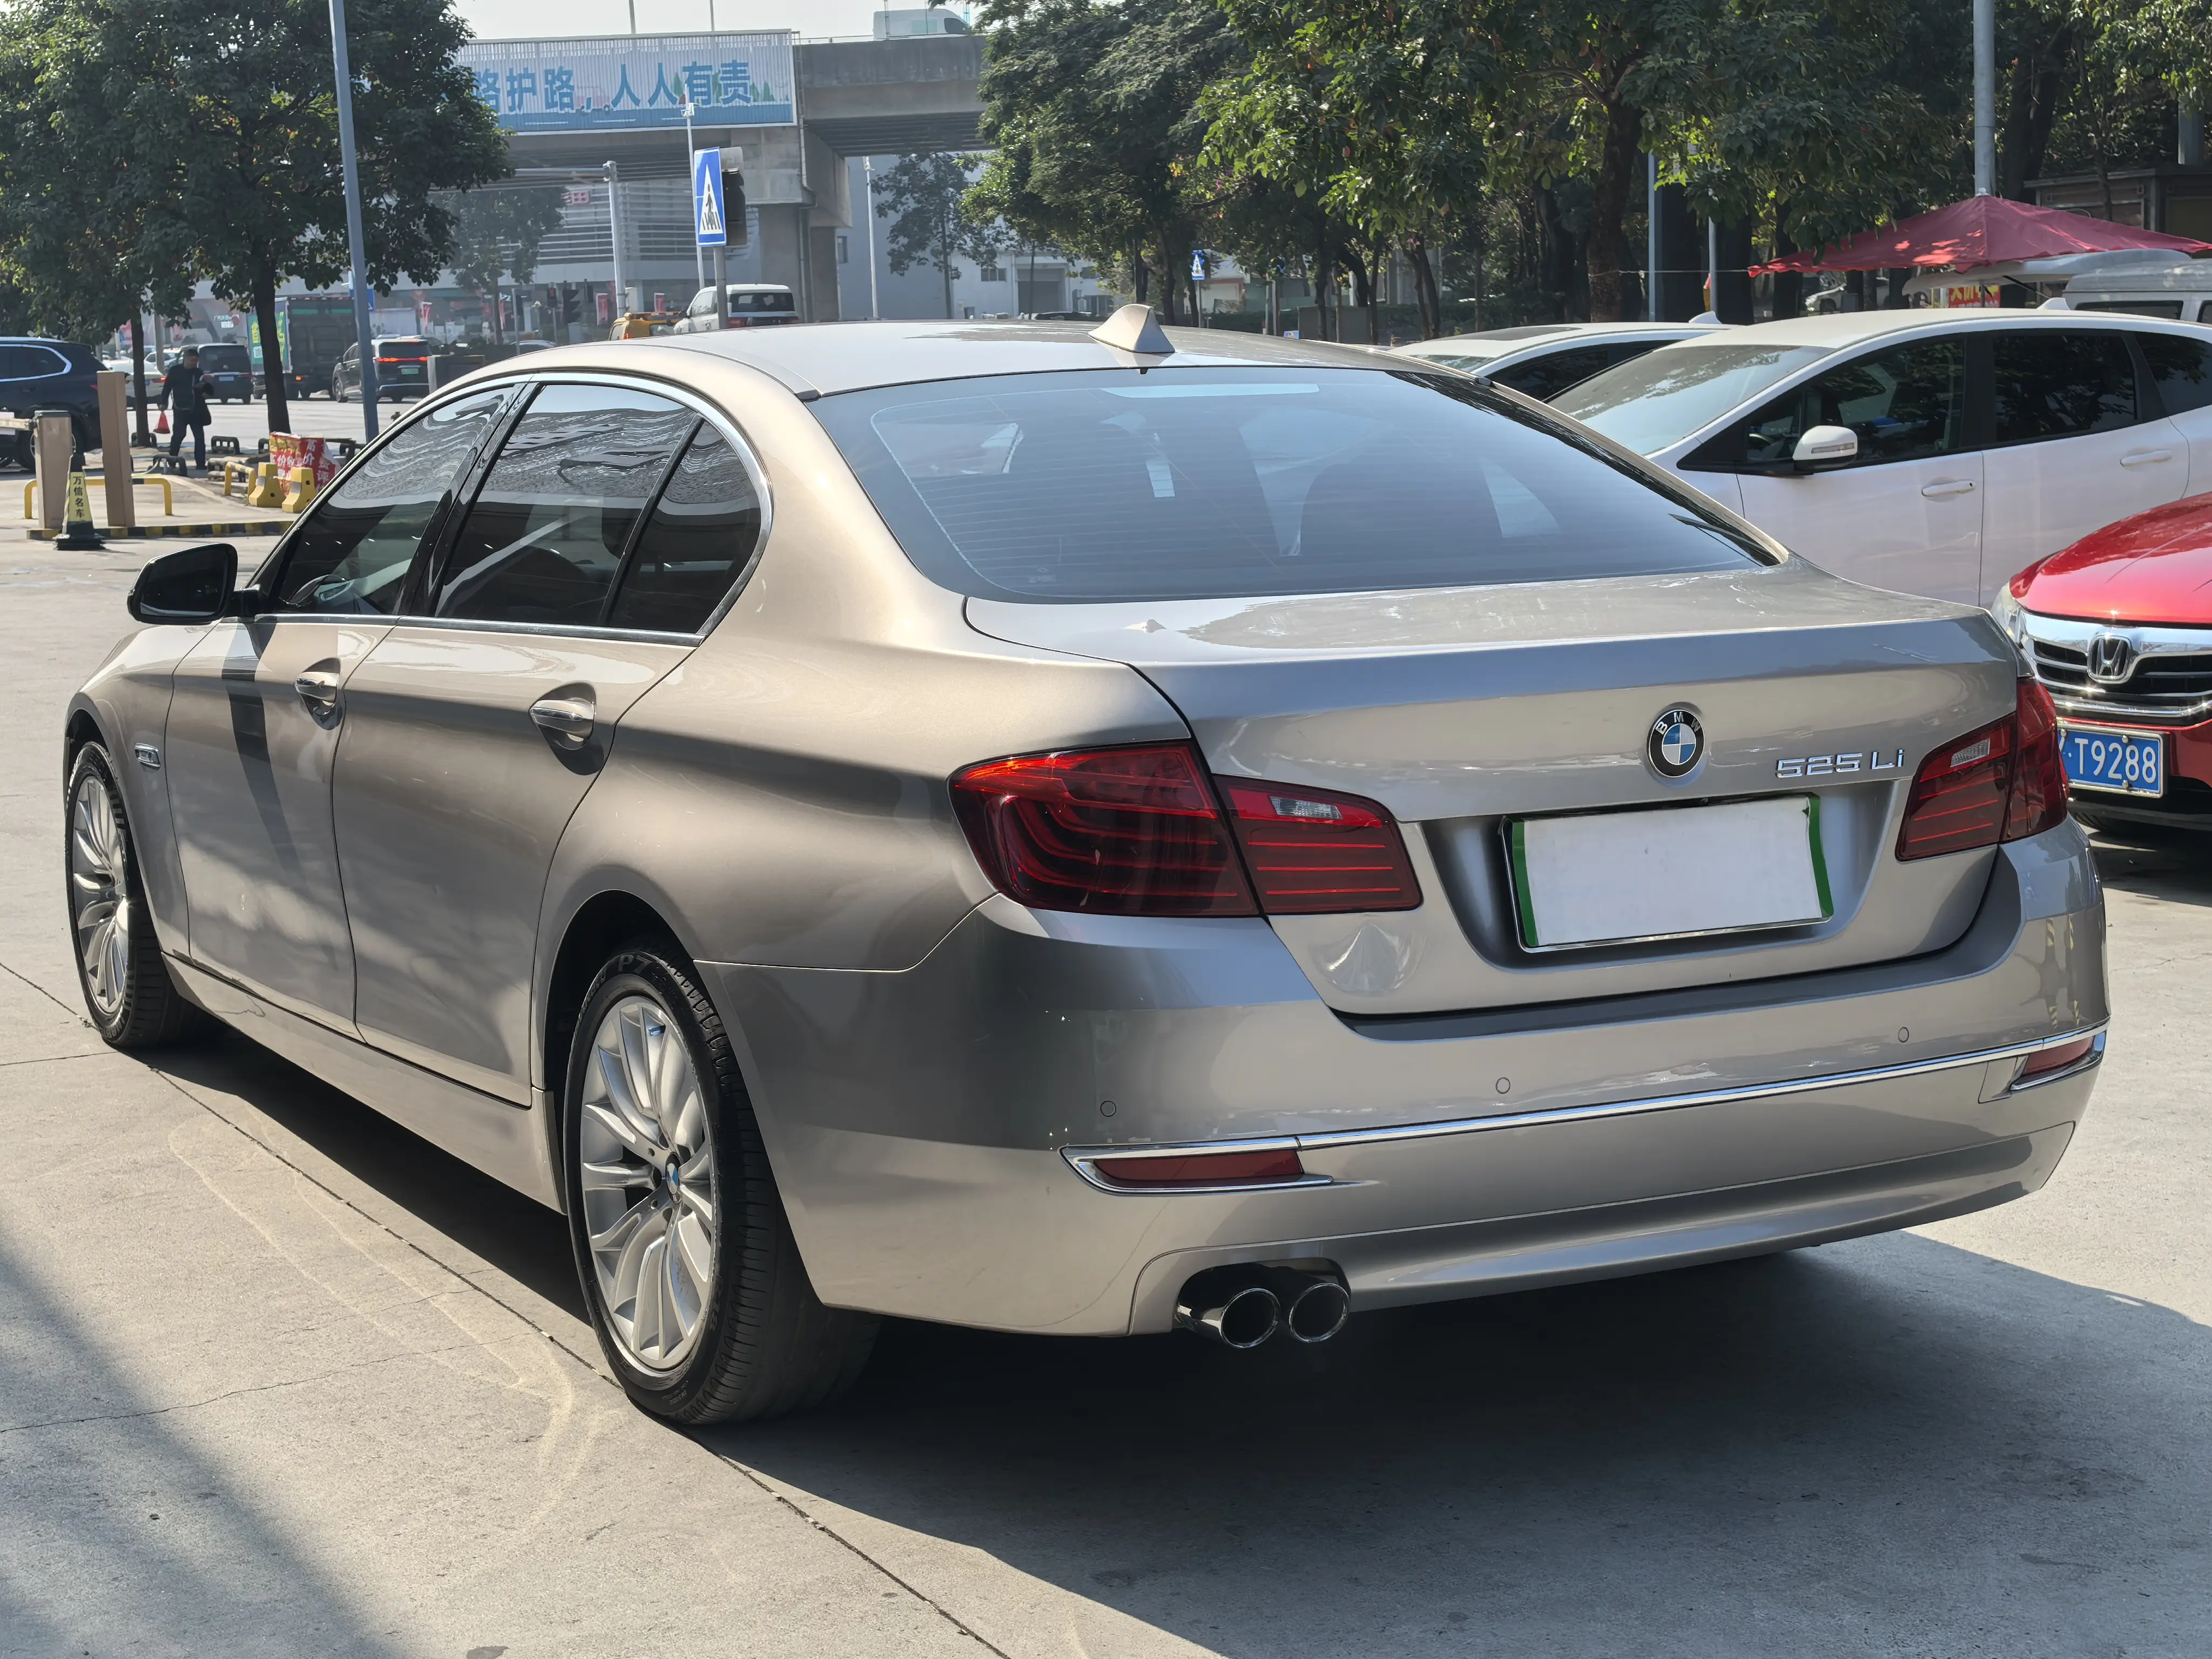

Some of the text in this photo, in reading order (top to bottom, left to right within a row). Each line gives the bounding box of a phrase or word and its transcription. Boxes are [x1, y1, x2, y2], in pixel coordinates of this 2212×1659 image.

[72, 476, 84, 518] 万信名车
[1655, 711, 1701, 735] BMW
